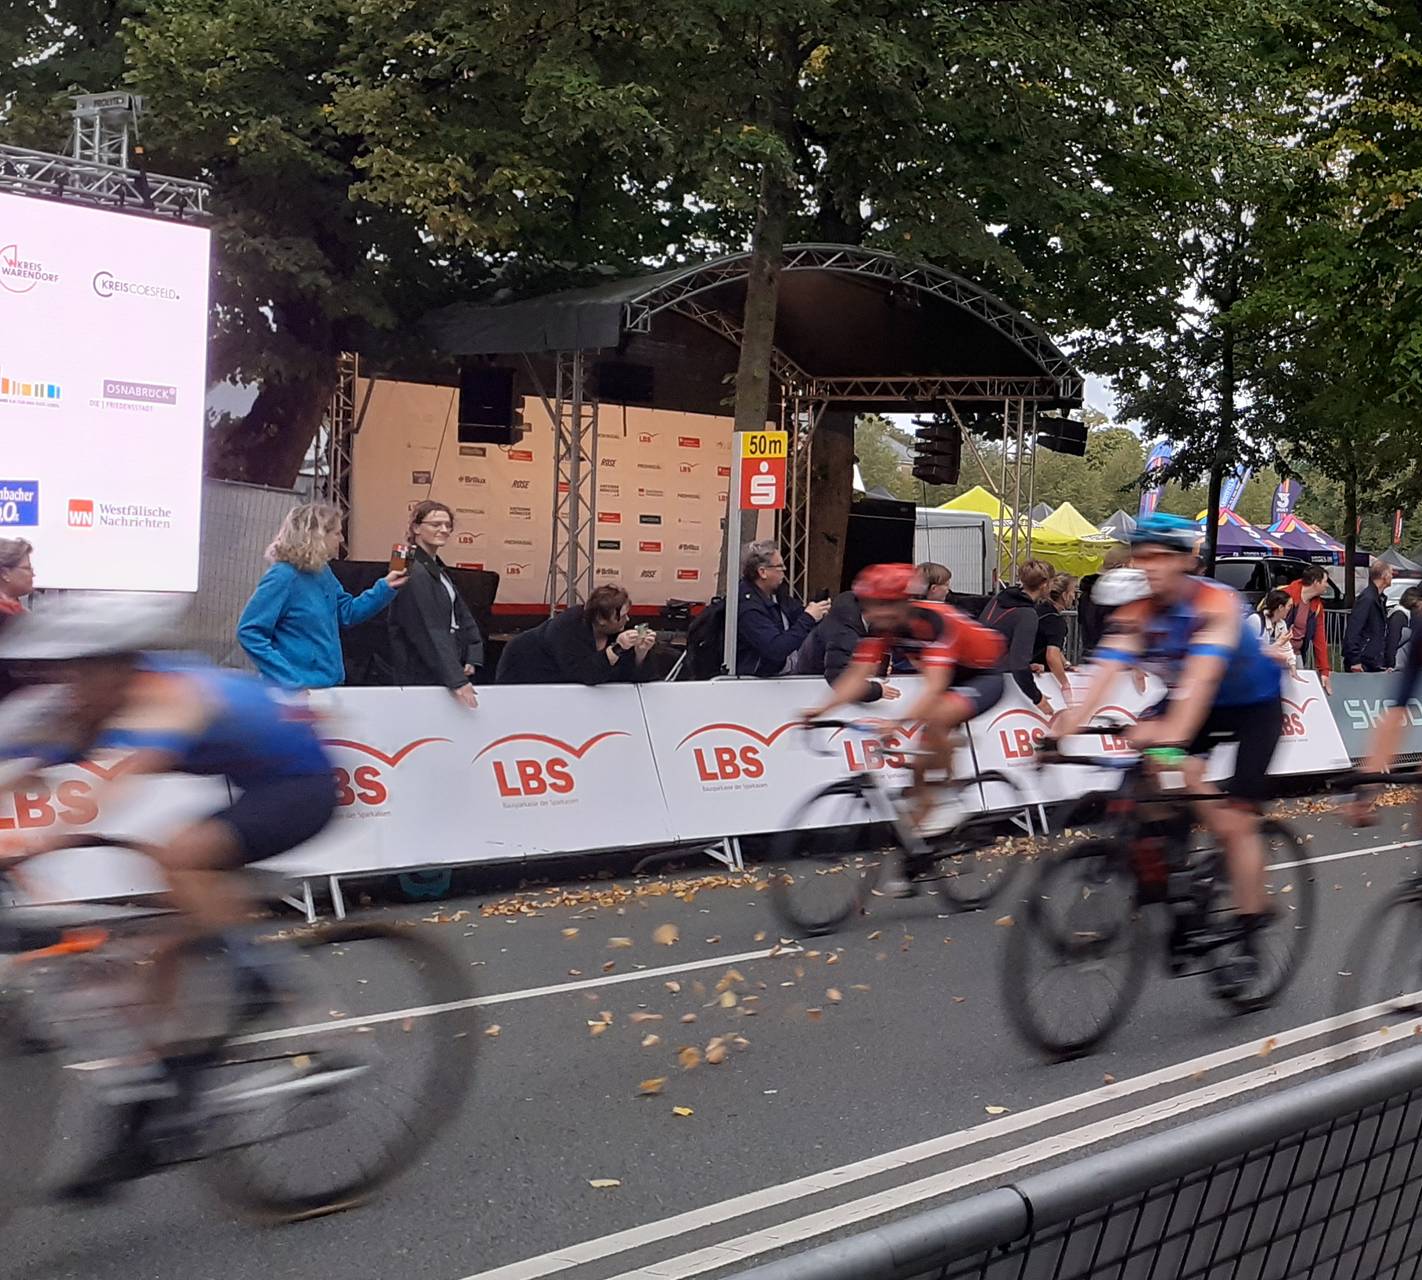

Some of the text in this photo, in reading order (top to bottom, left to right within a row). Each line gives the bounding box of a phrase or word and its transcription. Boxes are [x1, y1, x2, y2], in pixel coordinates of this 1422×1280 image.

[2, 267, 59, 282] WARENDORF
[17, 261, 42, 271] KREIS
[69, 510, 92, 525] WN
[99, 503, 172, 518] Westfälische
[99, 516, 171, 529] Nachrichten
[1280, 712, 1305, 736] BS
[843, 737, 906, 771] LBS
[693, 746, 765, 782] LBS
[332, 766, 387, 806] BS
[493, 757, 574, 797] LBS
